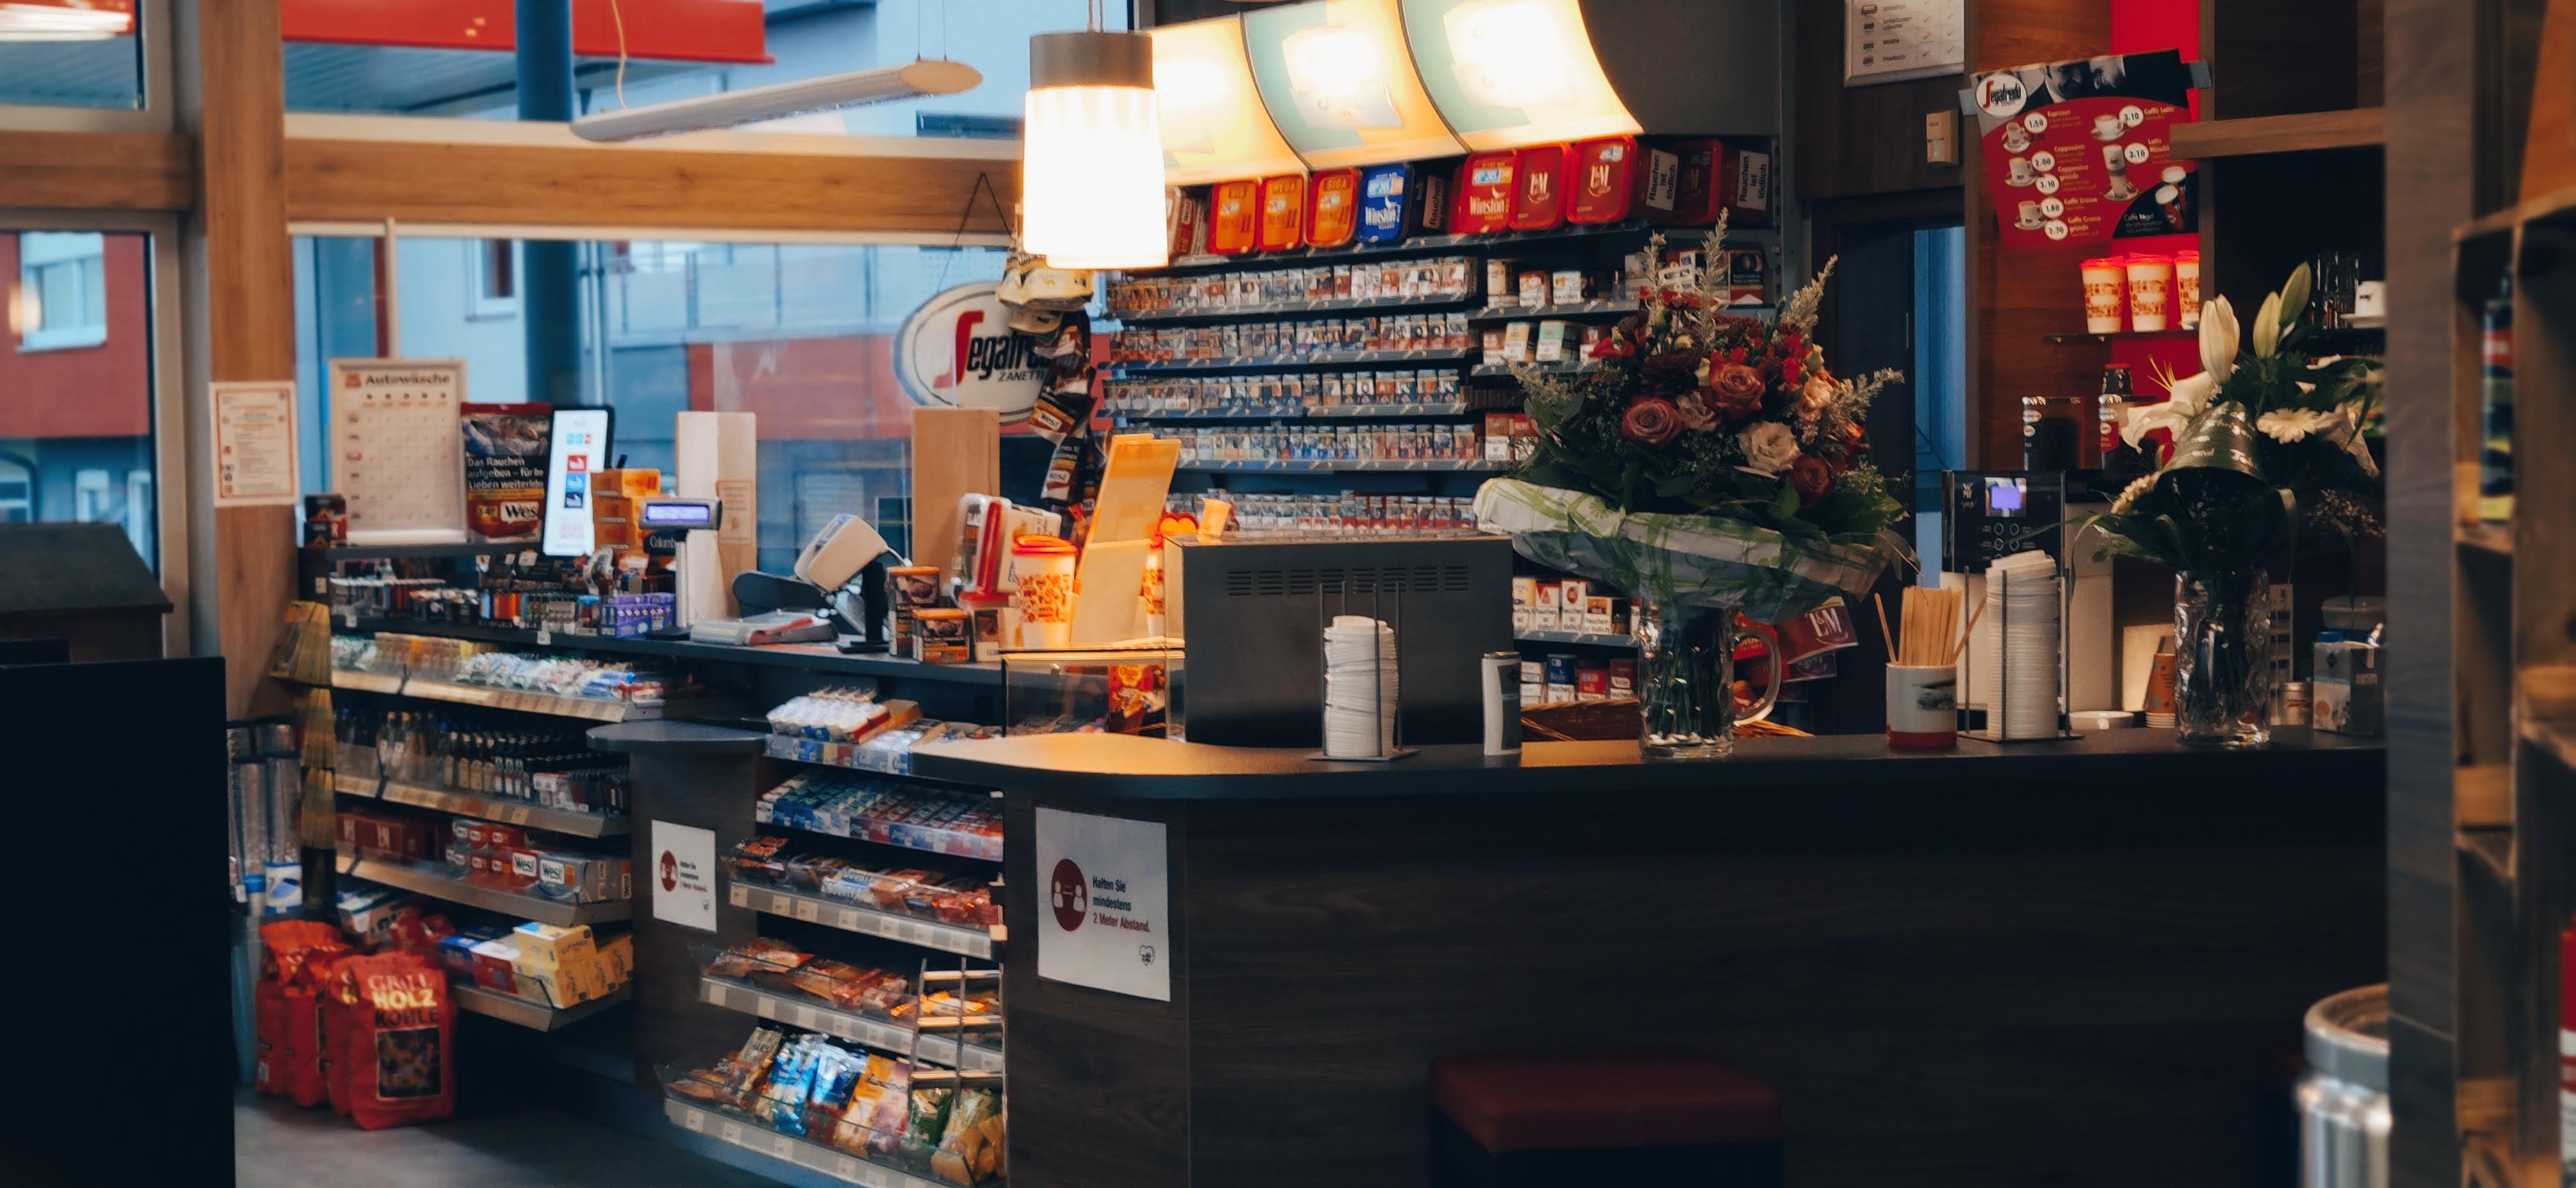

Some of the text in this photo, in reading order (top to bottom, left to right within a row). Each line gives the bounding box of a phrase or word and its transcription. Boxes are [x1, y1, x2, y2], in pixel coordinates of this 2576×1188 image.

[1648, 154, 1660, 201] Rauchen
[1739, 155, 1749, 202] Rauchen
[1470, 195, 1505, 215] Winston
[365, 372, 450, 385] Autowäsche
[468, 456, 525, 467] Das Rauchen
[468, 467, 511, 479] aufgeben
[469, 480, 499, 489] Lieben
[505, 505, 538, 519] Wes
[650, 535, 675, 549] Columb
[1809, 607, 1843, 637] L&M
[514, 855, 535, 872] West
[543, 867, 563, 881] West
[1092, 876, 1126, 893] Halten Sie
[1092, 895, 1131, 911] mindestens
[1093, 913, 1151, 933] 2 Meter Abstand.
[372, 988, 438, 1009] HOLZ
[374, 1007, 440, 1027] KOHLE
